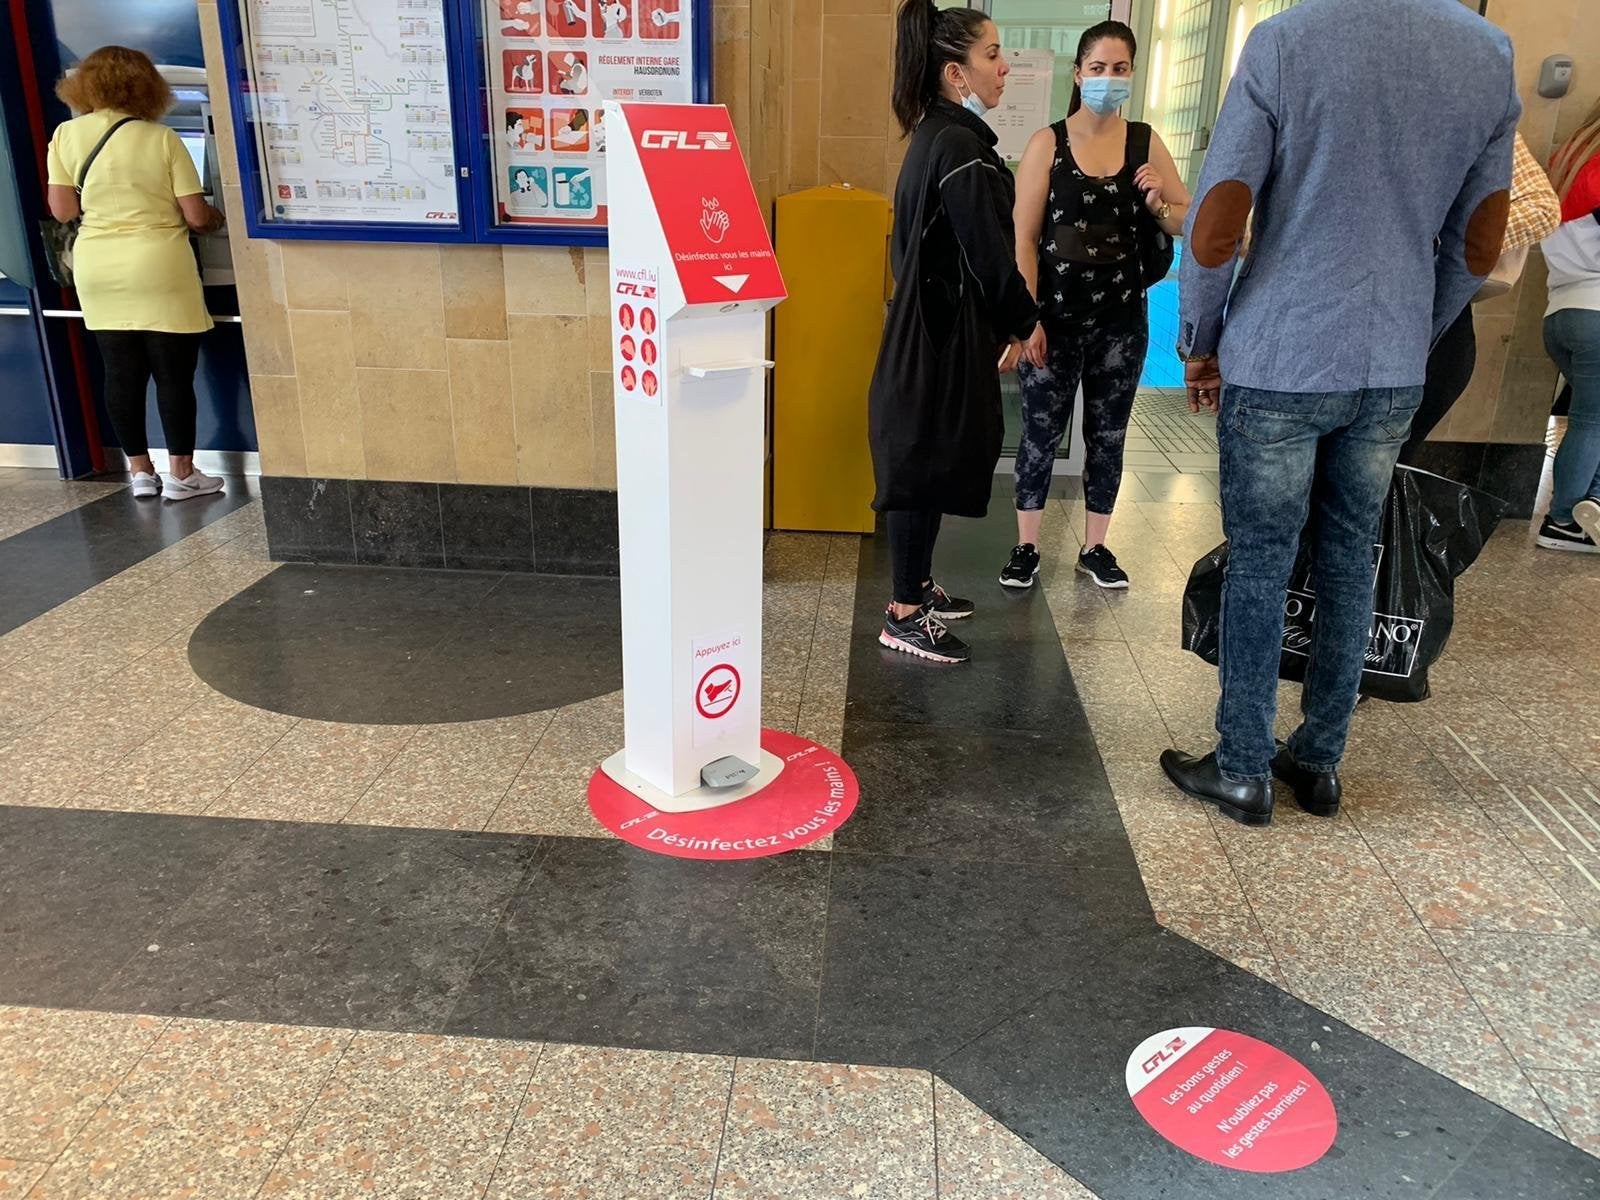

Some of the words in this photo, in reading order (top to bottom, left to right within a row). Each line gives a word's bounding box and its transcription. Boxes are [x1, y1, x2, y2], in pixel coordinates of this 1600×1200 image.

[634, 66, 680, 76] HAUSORDNUNG
[636, 56, 662, 65] INTERNE
[663, 57, 680, 66] GARE
[641, 129, 701, 150] CFL
[675, 252, 719, 261] Désinfectez
[721, 252, 738, 260] vous
[738, 250, 749, 258] les
[750, 249, 771, 258] mains
[724, 263, 733, 271] ici
[616, 282, 642, 297] CFL
[695, 640, 731, 659] Appuyez
[732, 636, 741, 646] ici
[823, 766, 845, 799] mains
[815, 800, 842, 817] les
[646, 828, 781, 850] Désinfectez
[782, 816, 827, 840] vous
[1161, 1089, 1184, 1106] Les
[1176, 1071, 1206, 1092] bons
[1202, 1048, 1233, 1075] gestes
[1187, 1101, 1203, 1114] au
[1199, 1065, 1244, 1103] quotidien
[1216, 1094, 1264, 1133] N'oubliez
[1258, 1081, 1279, 1099] pas
[1221, 1144, 1244, 1159] les
[1239, 1117, 1272, 1149] gestes
[1263, 1084, 1307, 1121] barrières
